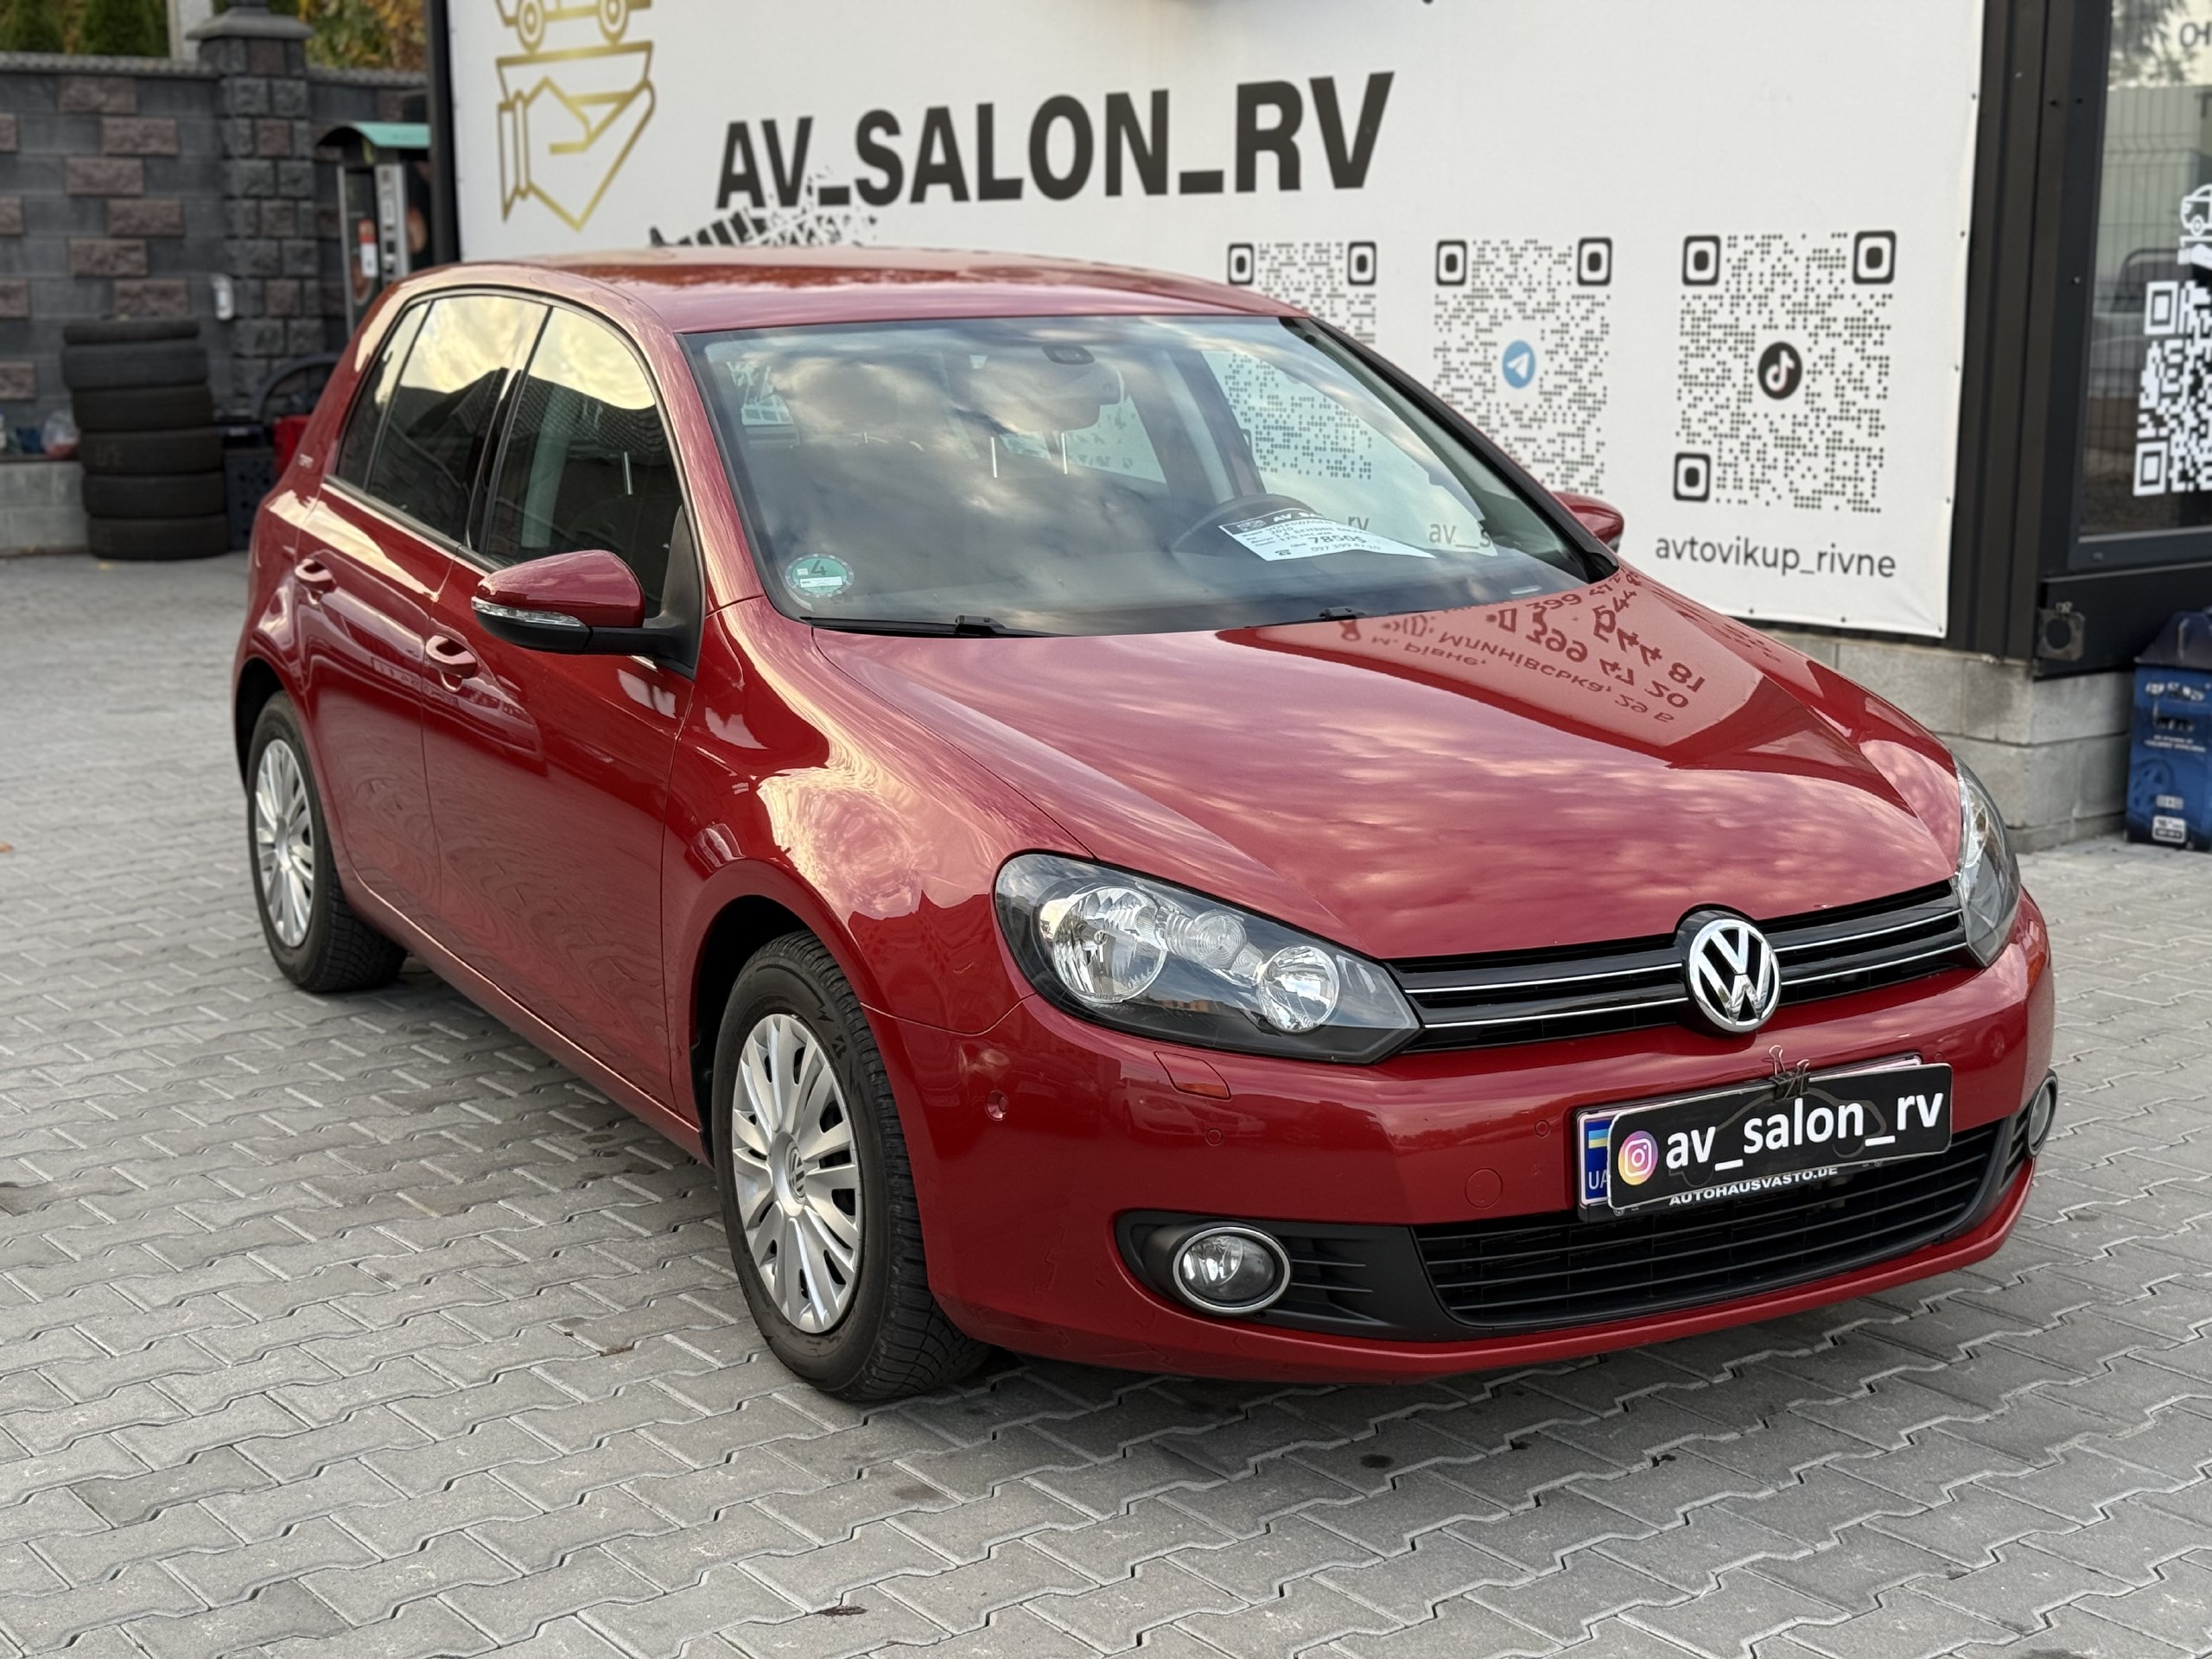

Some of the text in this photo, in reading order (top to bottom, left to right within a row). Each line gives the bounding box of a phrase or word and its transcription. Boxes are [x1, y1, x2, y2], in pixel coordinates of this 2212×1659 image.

[715, 71, 1395, 210] AV_SALON_RV
[1656, 536, 1897, 578] avtovikup_rivne
[1665, 1091, 1944, 1172] av_salon_rv
[1669, 1166, 1839, 1206] AUTOHAUSVASTO.DE
